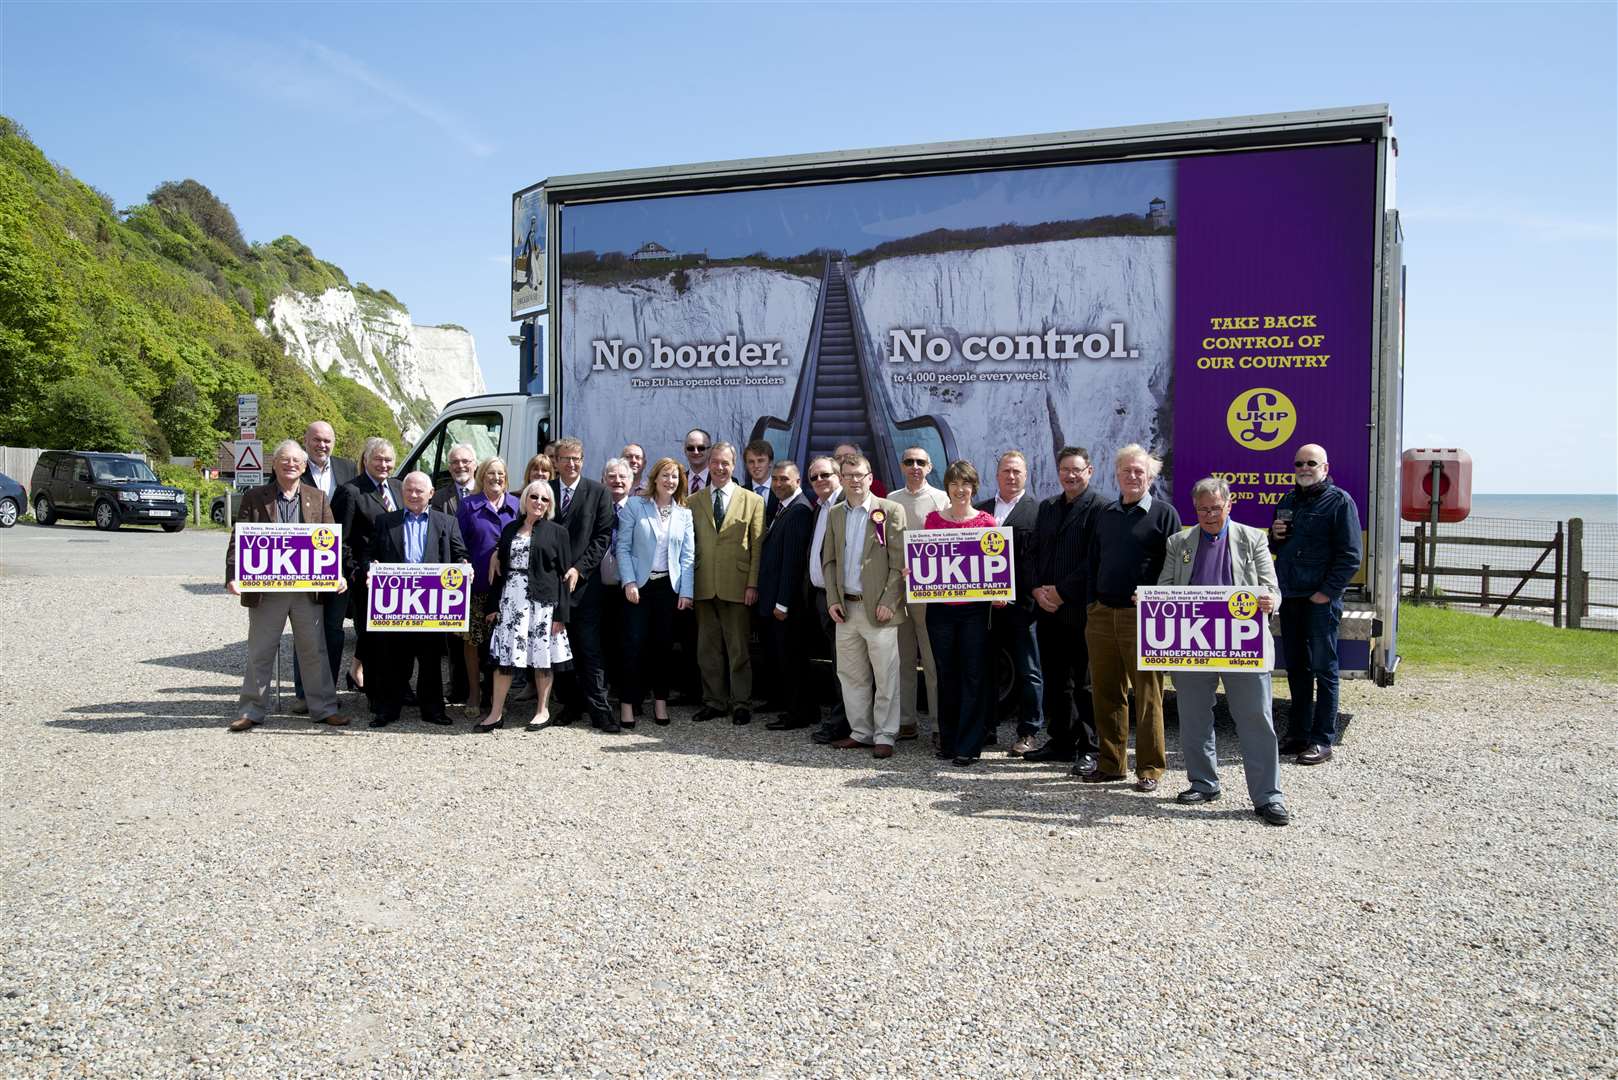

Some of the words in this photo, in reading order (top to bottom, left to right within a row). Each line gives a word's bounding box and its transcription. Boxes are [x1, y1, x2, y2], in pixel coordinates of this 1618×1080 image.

[1211, 317, 1259, 330] TAKE
[1264, 315, 1317, 329] BACK
[889, 329, 951, 363] No
[962, 323, 1139, 361] control.
[1202, 336, 1294, 350] CONTROL
[1298, 335, 1325, 348] OF
[592, 340, 643, 370] No
[651, 336, 788, 369] border.
[1197, 357, 1235, 369] OUR
[1239, 355, 1330, 369] COUNTRY
[632, 378, 648, 387] The
[652, 378, 665, 387] EU
[667, 377, 684, 386] has
[686, 377, 722, 389] opened
[725, 378, 741, 386] our
[893, 373, 904, 382] to
[906, 372, 936, 384] 4,000
[938, 371, 977, 384] people
[979, 372, 1012, 383] every
[1014, 370, 1050, 381] week.
[1236, 411, 1289, 421] UKIP
[1264, 473, 1296, 485] UKI
[244, 536, 292, 549] VOTE
[912, 543, 960, 557] VOTE
[243, 549, 336, 574] UKIP
[912, 555, 1007, 584] UKIP
[377, 576, 422, 588] VOTE
[375, 589, 463, 614] UKIP
[1147, 602, 1204, 617] VOTE
[1146, 618, 1259, 649] UKIP
[1229, 658, 1259, 666] ukip.org
